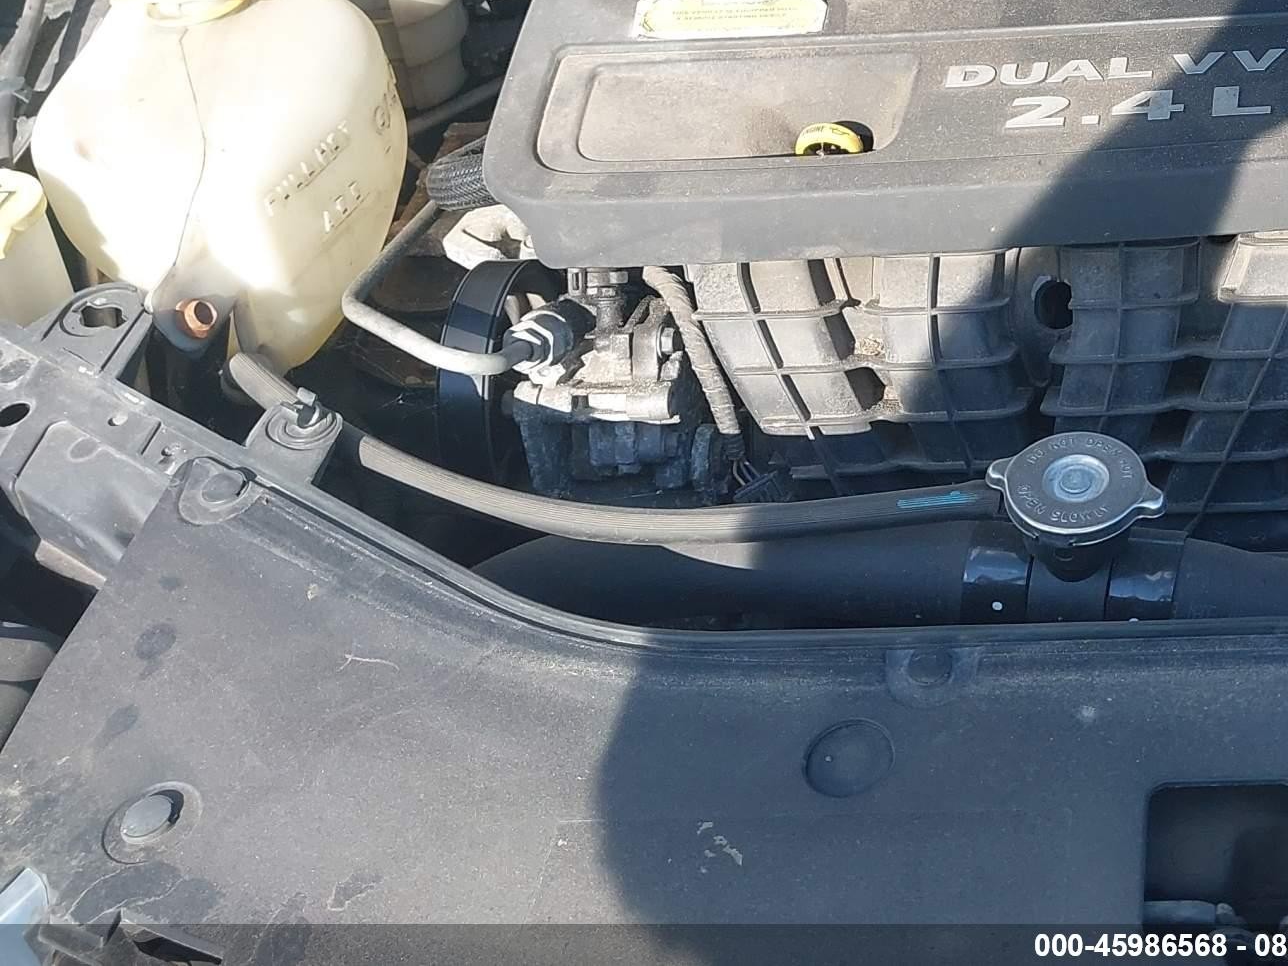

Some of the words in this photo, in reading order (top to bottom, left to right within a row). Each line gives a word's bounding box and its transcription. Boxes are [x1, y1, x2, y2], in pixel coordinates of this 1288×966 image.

[944, 56, 1153, 89] DUAL
[1026, 449, 1046, 467] DO
[1049, 437, 1075, 451] NOT
[1085, 436, 1123, 457] OPEN
[1119, 458, 1136, 480] HOT
[1017, 482, 1047, 516] OPEN
[1049, 504, 1111, 524] SLOWLY
